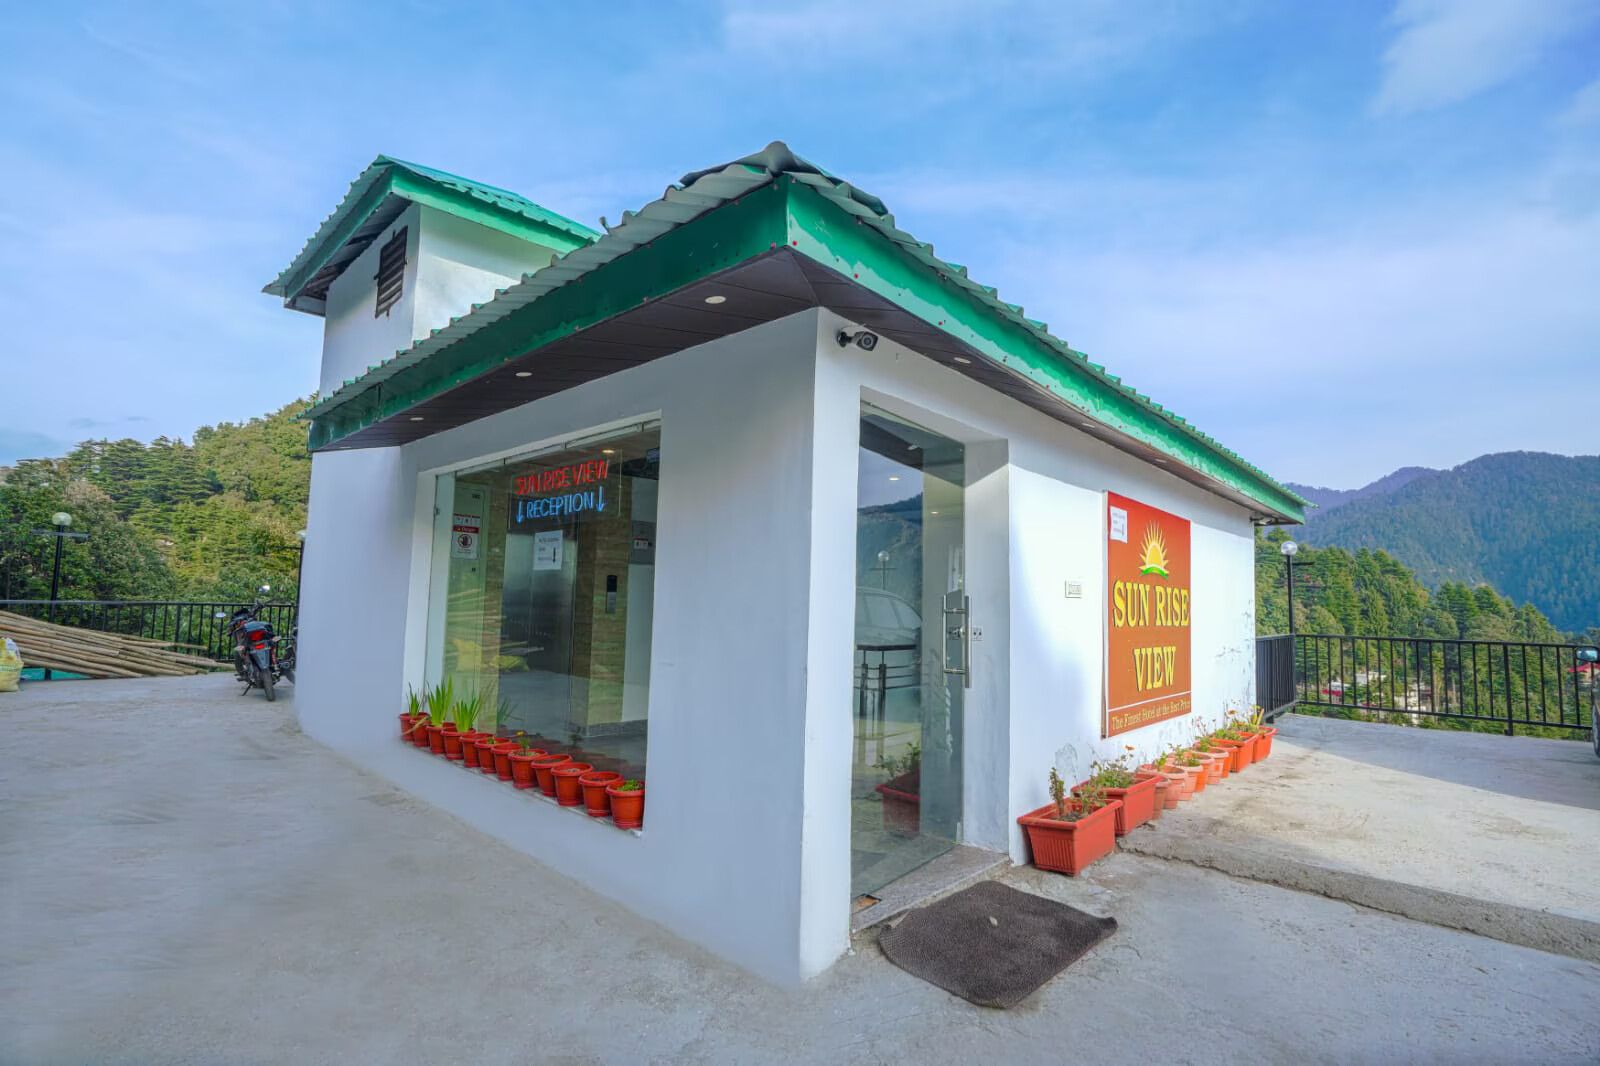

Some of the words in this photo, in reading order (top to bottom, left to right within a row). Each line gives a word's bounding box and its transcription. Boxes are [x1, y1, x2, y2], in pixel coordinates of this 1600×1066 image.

[514, 474, 541, 496] SUN
[543, 466, 571, 490] RISE
[572, 458, 609, 485] VIEW
[527, 491, 594, 518] RECEPTION
[1113, 580, 1150, 628] SUN
[1155, 585, 1189, 627] RISE
[1133, 646, 1176, 692] VIEW
[1112, 716, 1123, 730] The
